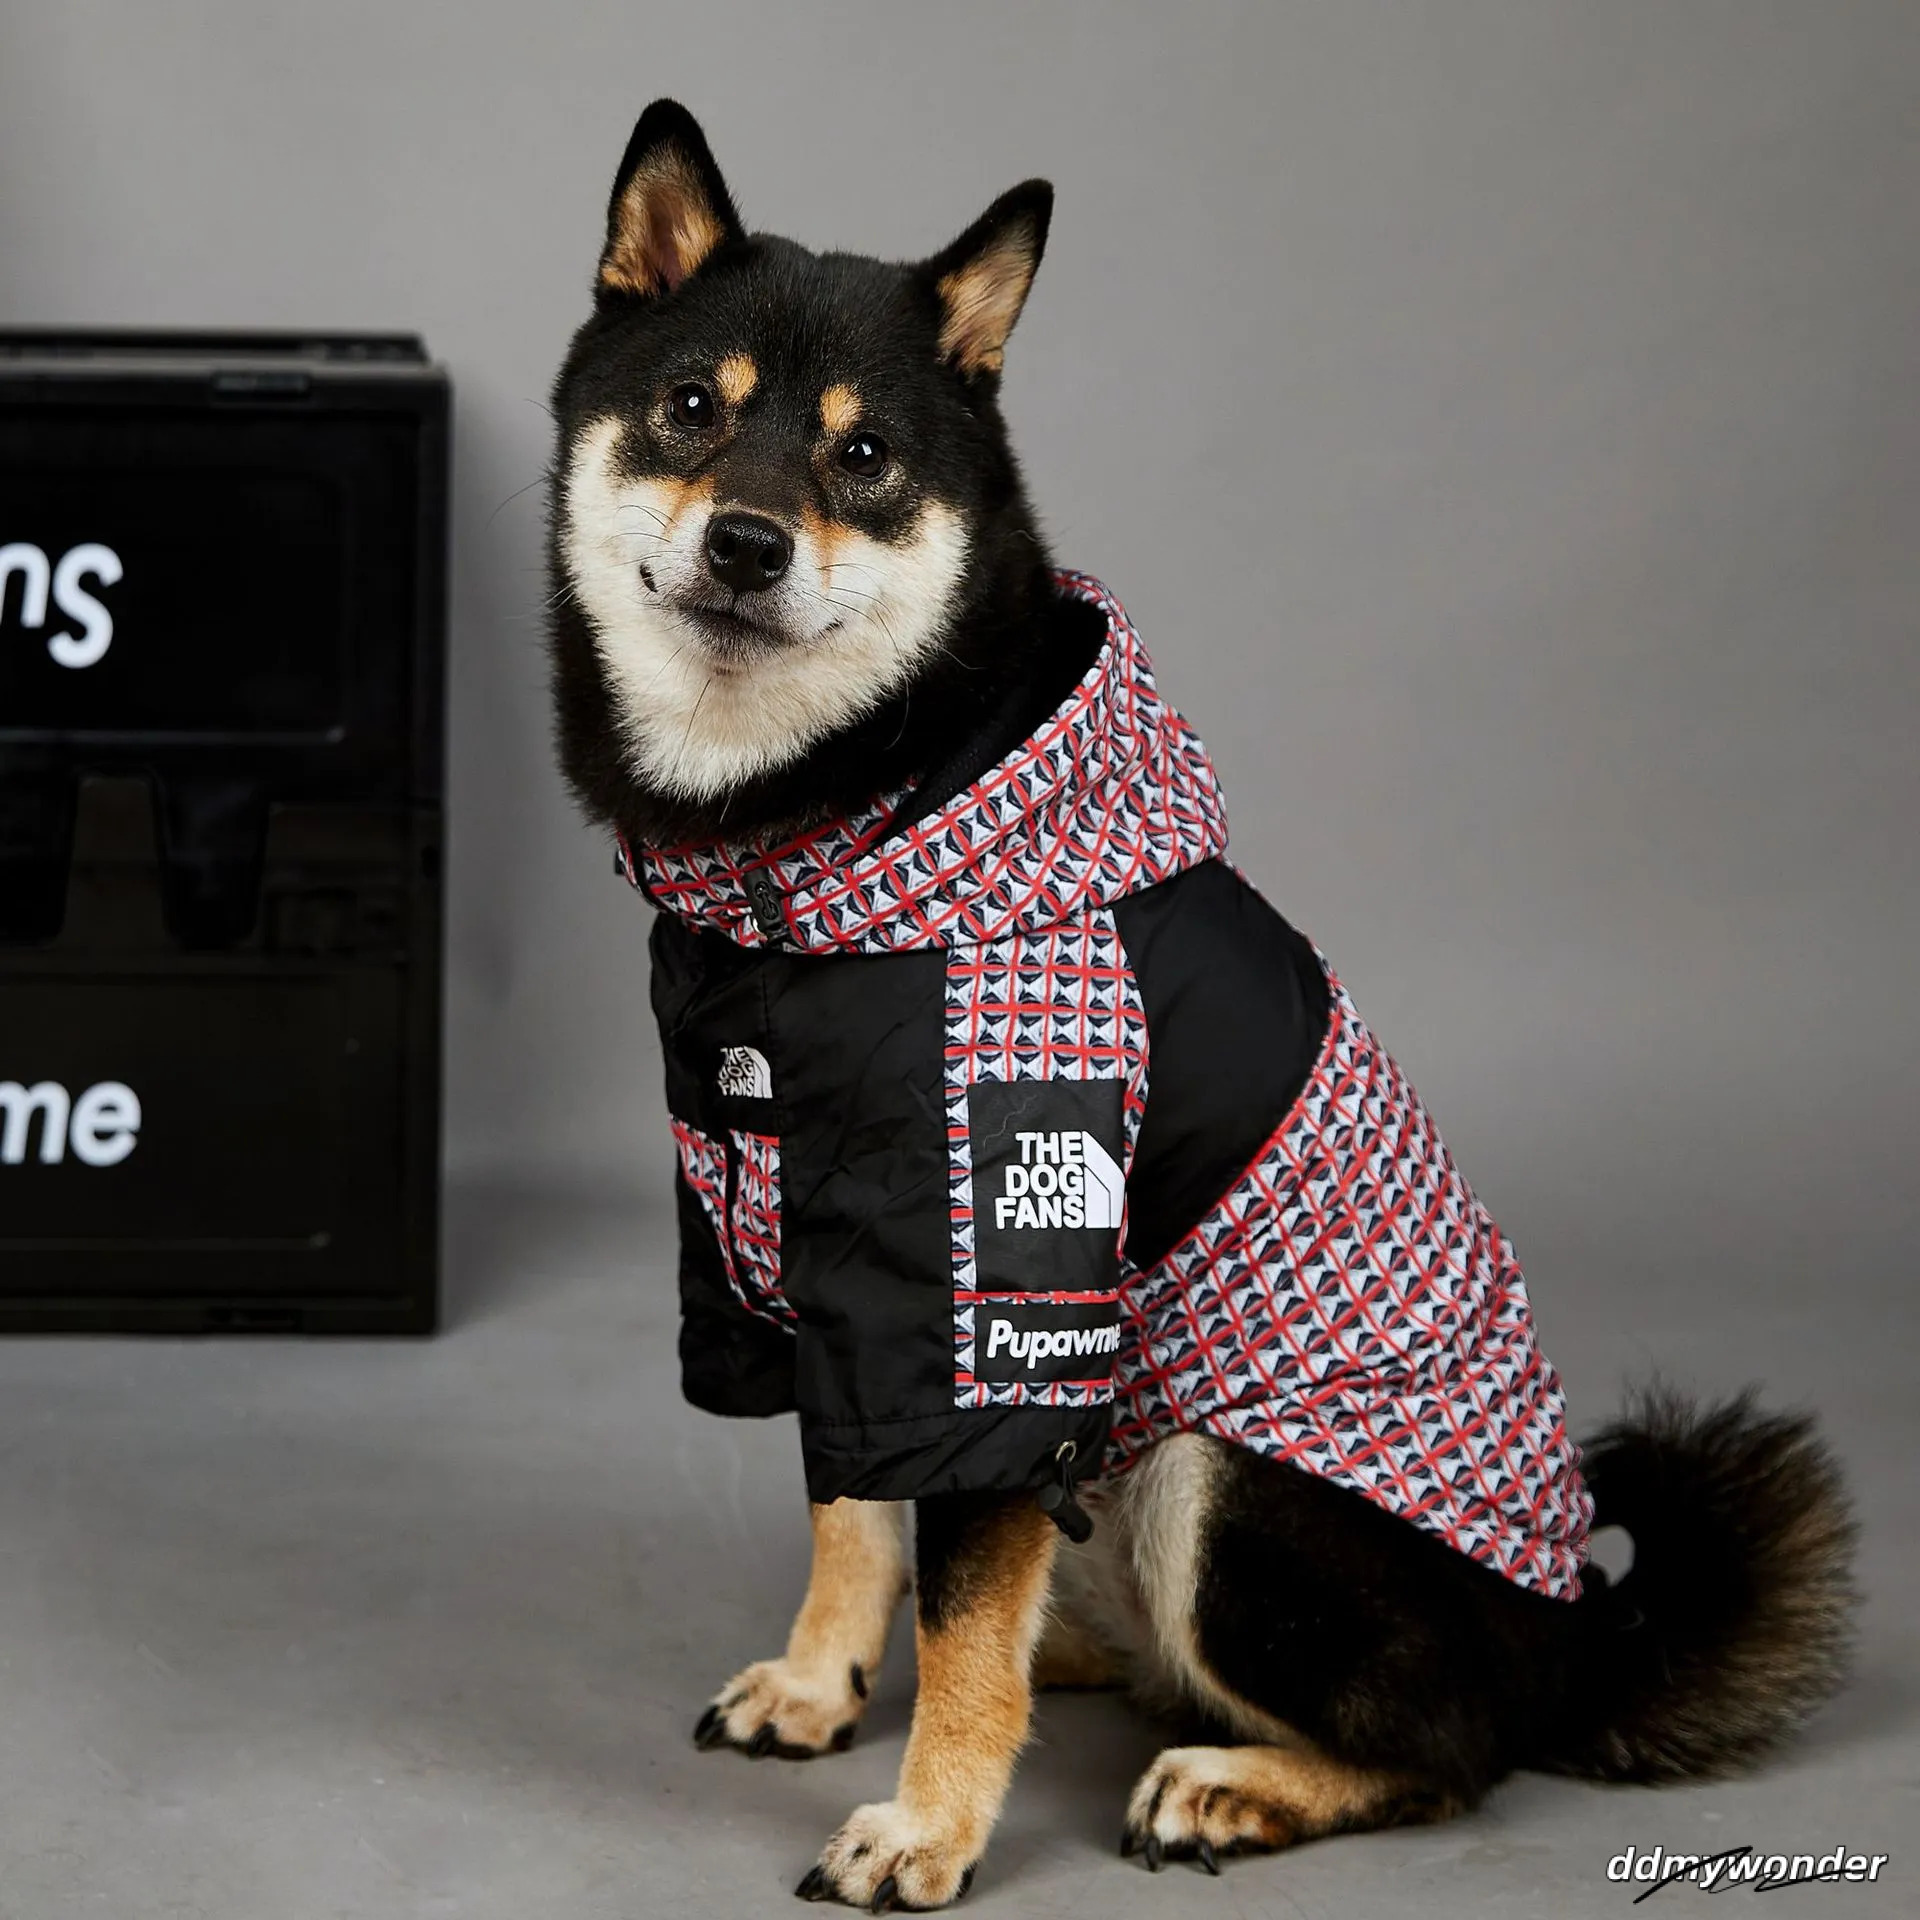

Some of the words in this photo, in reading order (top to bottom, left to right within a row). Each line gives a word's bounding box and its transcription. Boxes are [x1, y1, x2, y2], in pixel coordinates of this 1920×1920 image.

[717, 1077, 755, 1098] FANS
[718, 1060, 755, 1081] DOG
[1014, 1131, 1084, 1165] THE
[1004, 1163, 1084, 1198] DOG
[994, 1196, 1085, 1230] FANS
